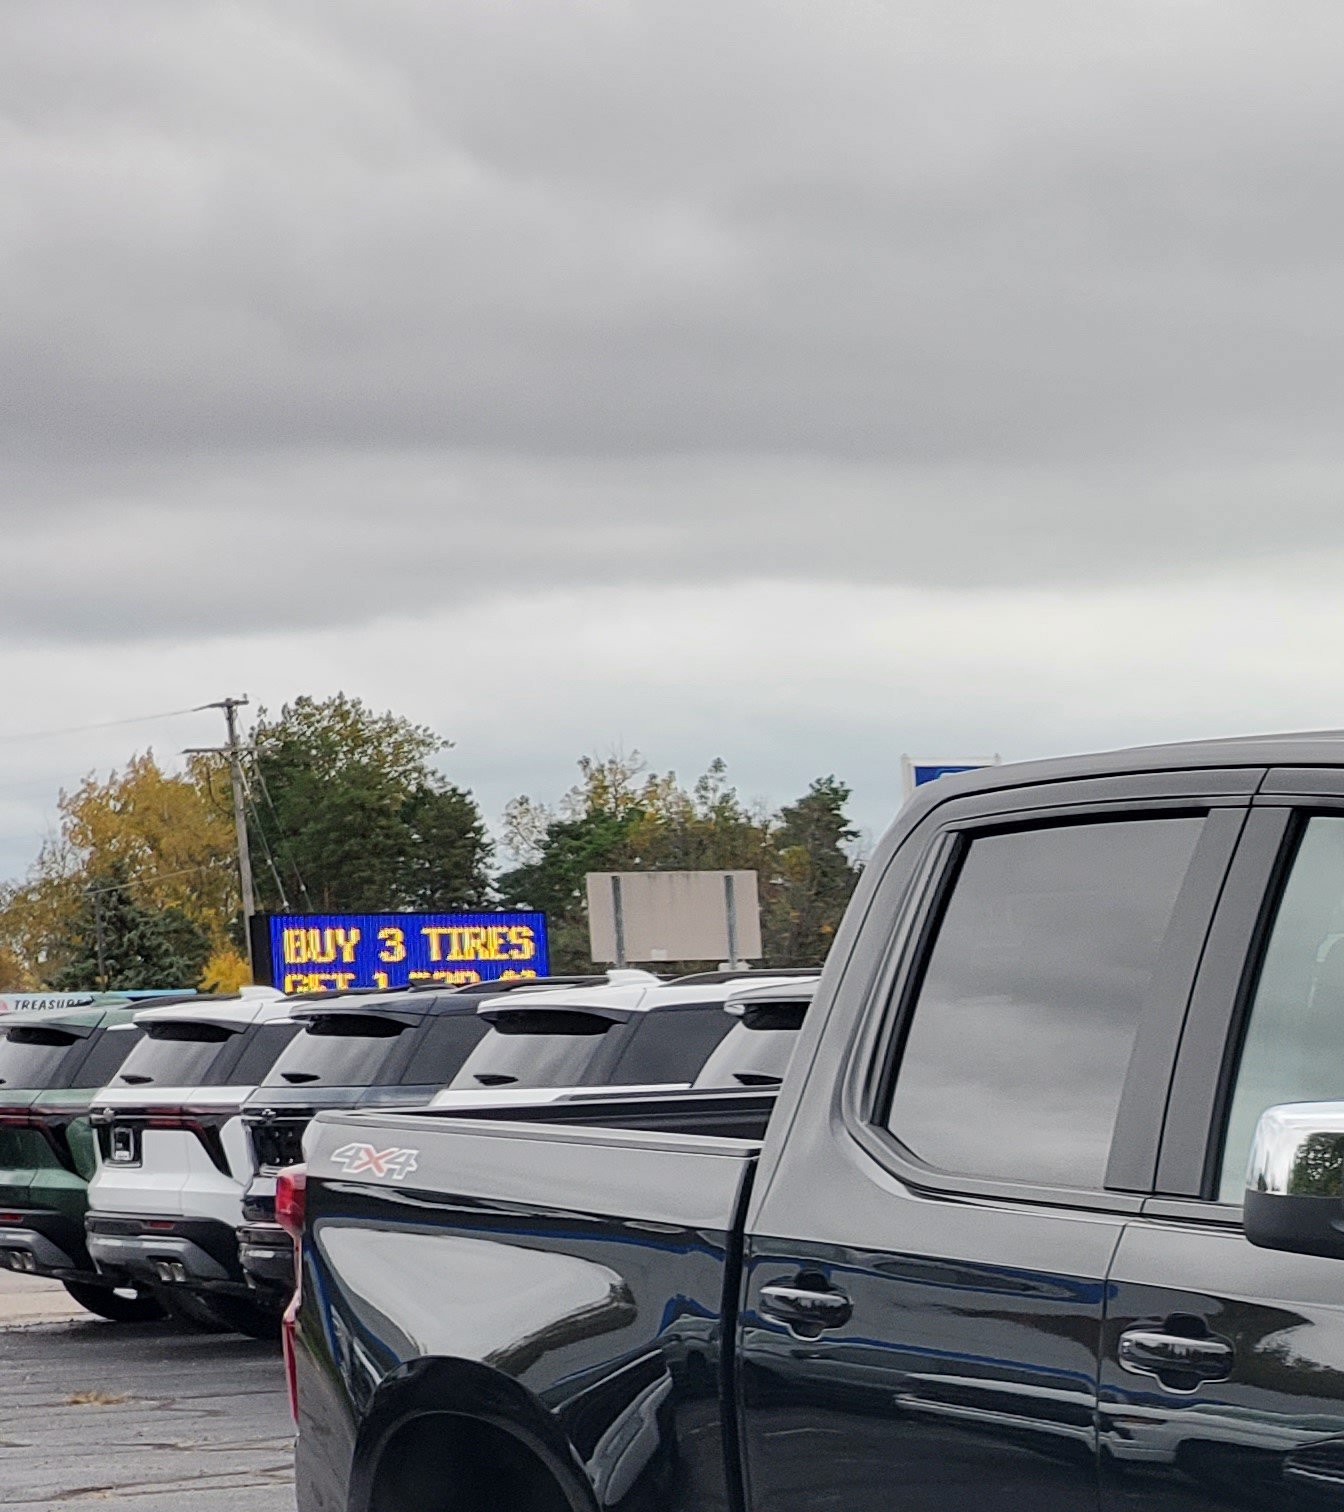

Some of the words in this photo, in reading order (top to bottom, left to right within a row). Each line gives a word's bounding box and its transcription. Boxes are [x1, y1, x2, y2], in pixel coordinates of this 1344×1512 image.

[284, 927, 360, 963] BUY
[377, 927, 407, 961] 3
[421, 926, 535, 961] TIRES
[14, 999, 82, 1010] TREASUR
